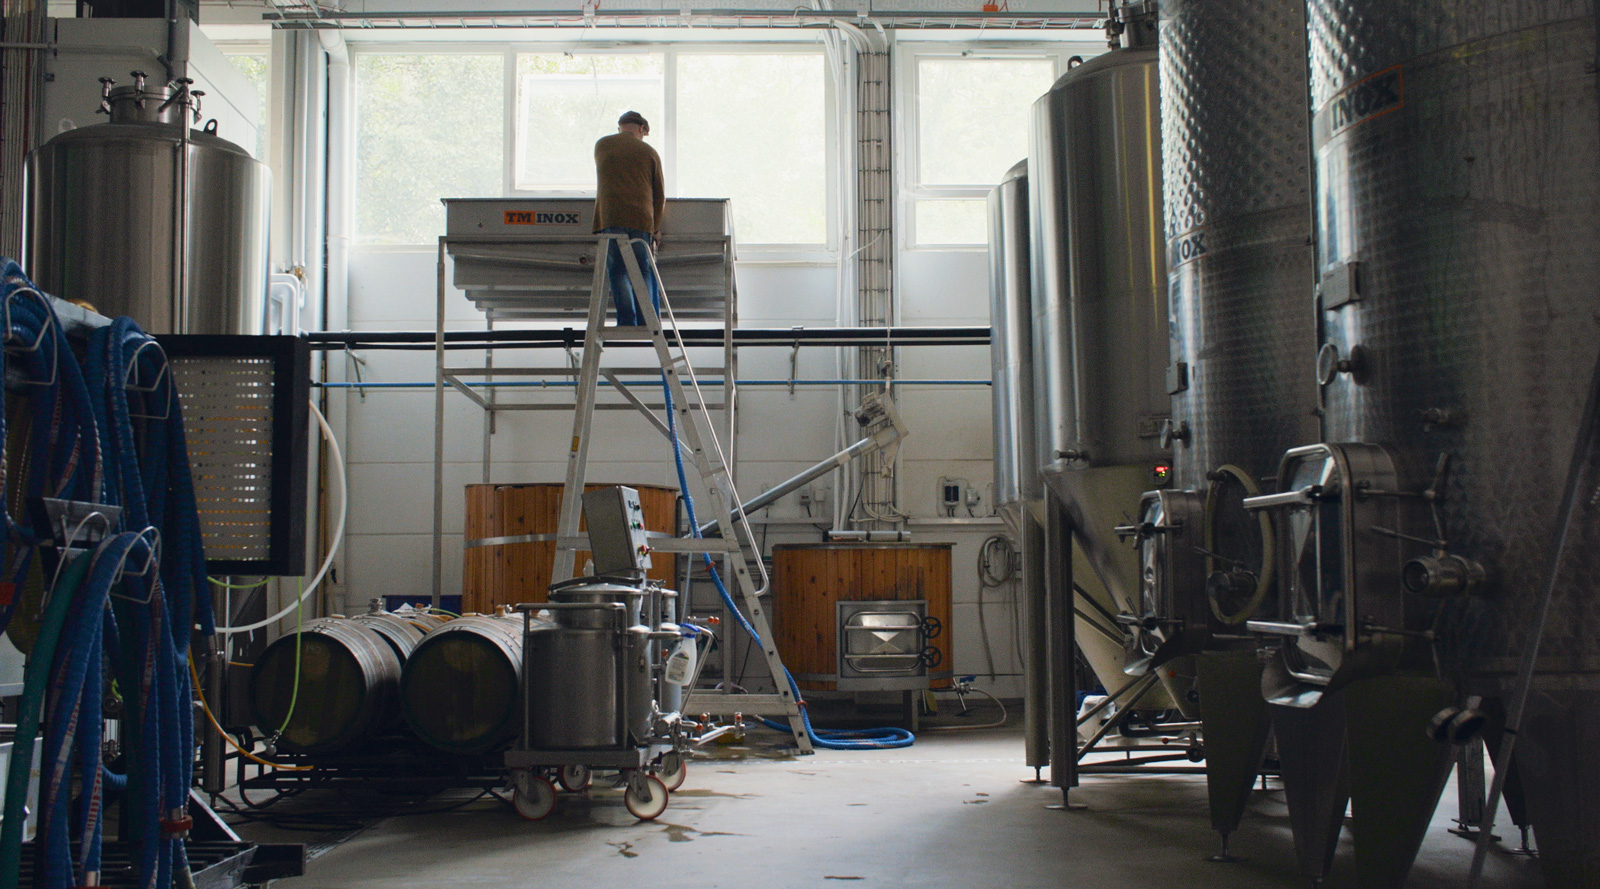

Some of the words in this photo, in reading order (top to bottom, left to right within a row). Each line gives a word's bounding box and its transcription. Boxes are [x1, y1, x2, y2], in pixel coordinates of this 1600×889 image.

[1332, 73, 1398, 131] INOX
[506, 212, 532, 223] TM
[536, 213, 579, 224] INOX
